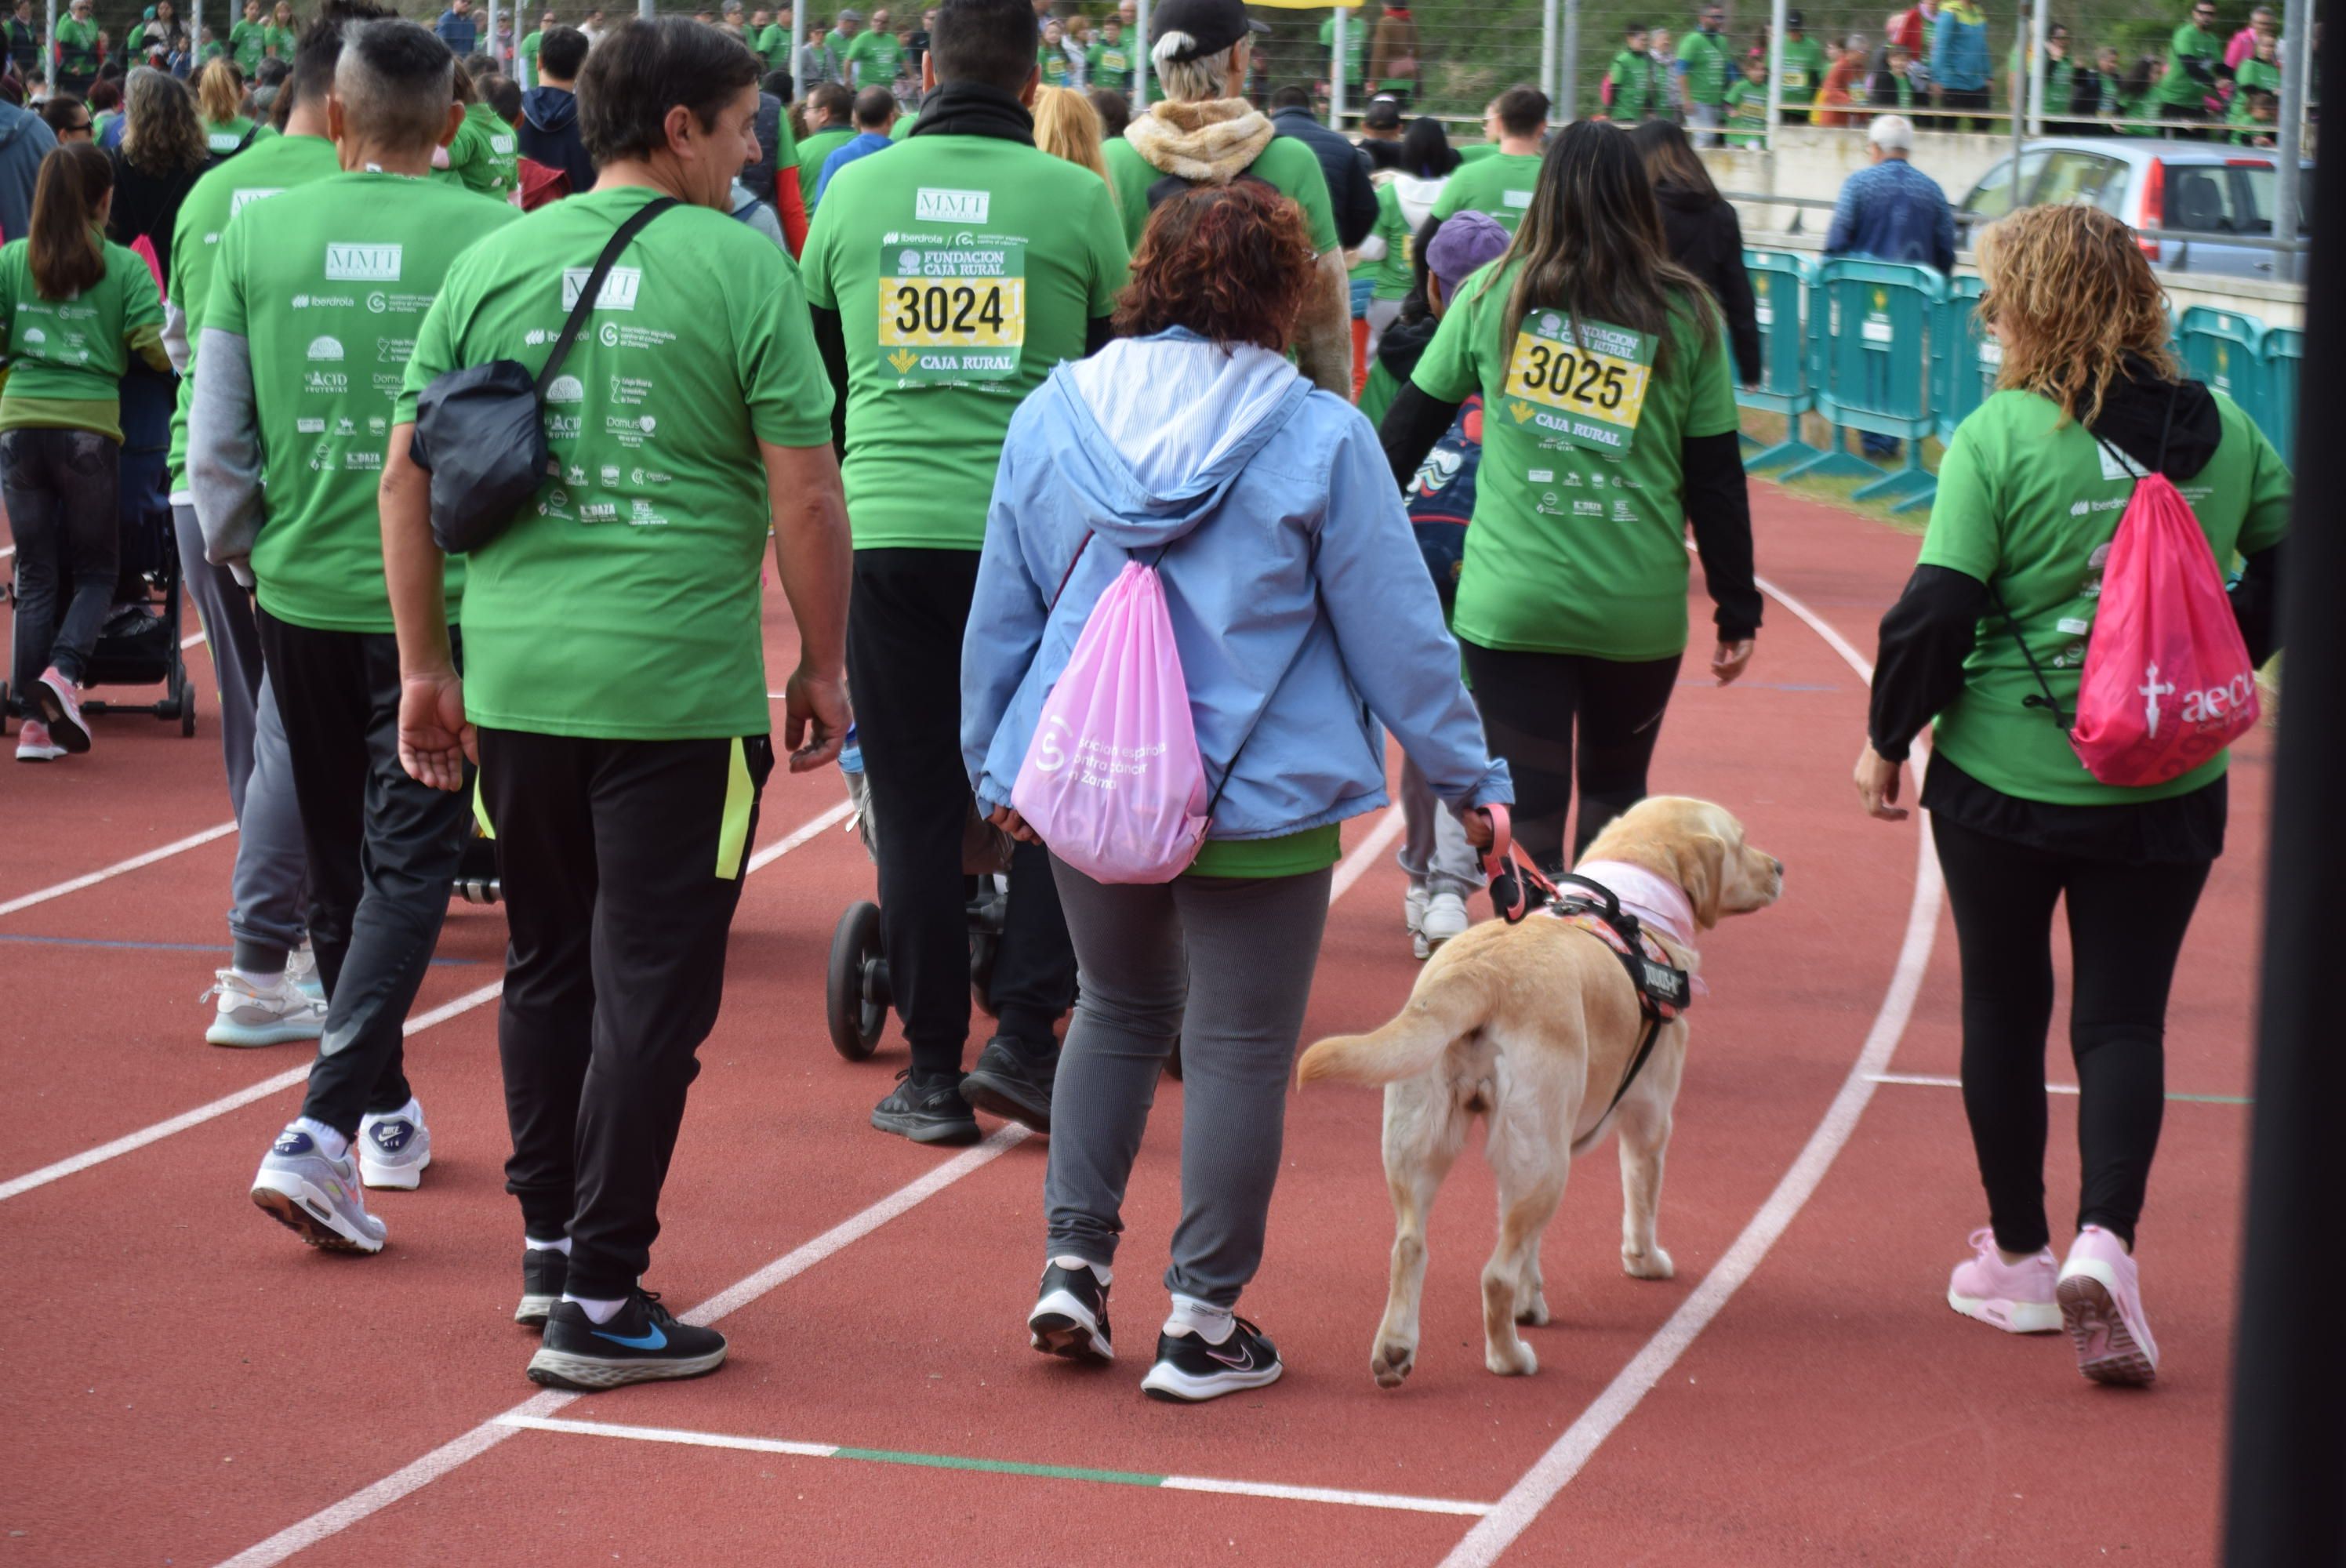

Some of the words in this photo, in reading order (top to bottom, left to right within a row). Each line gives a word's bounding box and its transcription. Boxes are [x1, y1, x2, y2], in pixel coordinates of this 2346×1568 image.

[920, 194, 987, 213] MMT
[901, 232, 942, 245] Iberdrola
[329, 249, 400, 269] MMT
[924, 250, 1004, 264] FUNDACION
[924, 263, 957, 277] CAJA
[959, 263, 1004, 276] RURAL
[311, 296, 354, 307] Iberdrola
[895, 285, 1004, 334] 3024
[1563, 320, 1639, 350] FNDACION
[1592, 339, 1634, 360] RURAL
[920, 355, 957, 371] CAJA
[962, 355, 1013, 370] RURAL
[373, 373, 405, 384] Domu
[1523, 345, 1628, 410] 3025
[606, 416, 640, 430] Domus
[1534, 412, 1570, 433] CAJA
[1572, 422, 1622, 448] RURAL
[2091, 499, 2128, 512] Iberdro
[382, 1125, 401, 1135] NIKE
